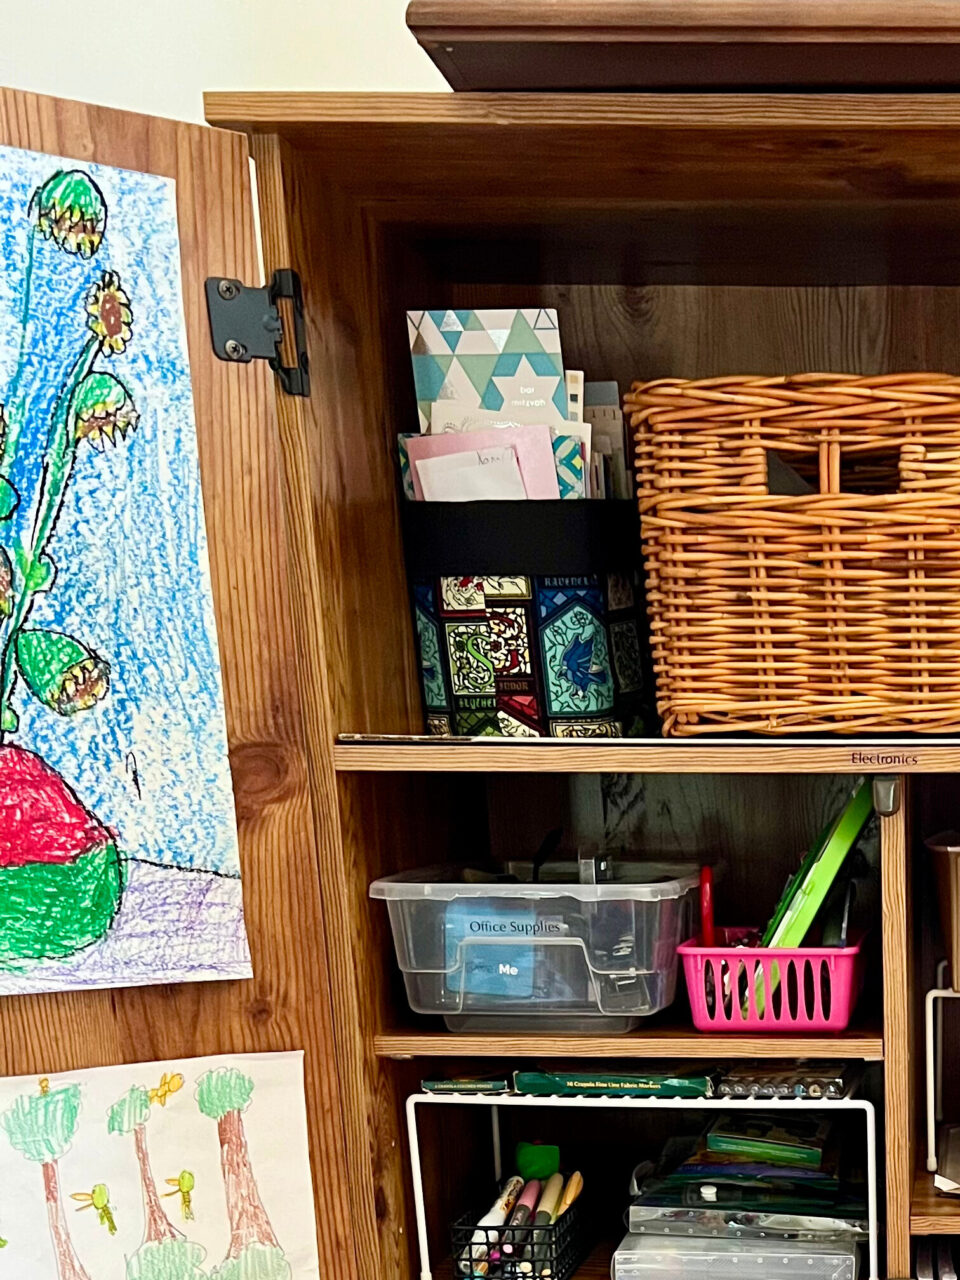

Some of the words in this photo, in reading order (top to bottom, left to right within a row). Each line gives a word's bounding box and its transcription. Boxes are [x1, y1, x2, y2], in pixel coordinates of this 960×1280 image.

[851, 752, 918, 765] Electronics
[469, 920, 507, 932] Office
[510, 921, 560, 935] Supplies
[498, 963, 519, 976] Me
